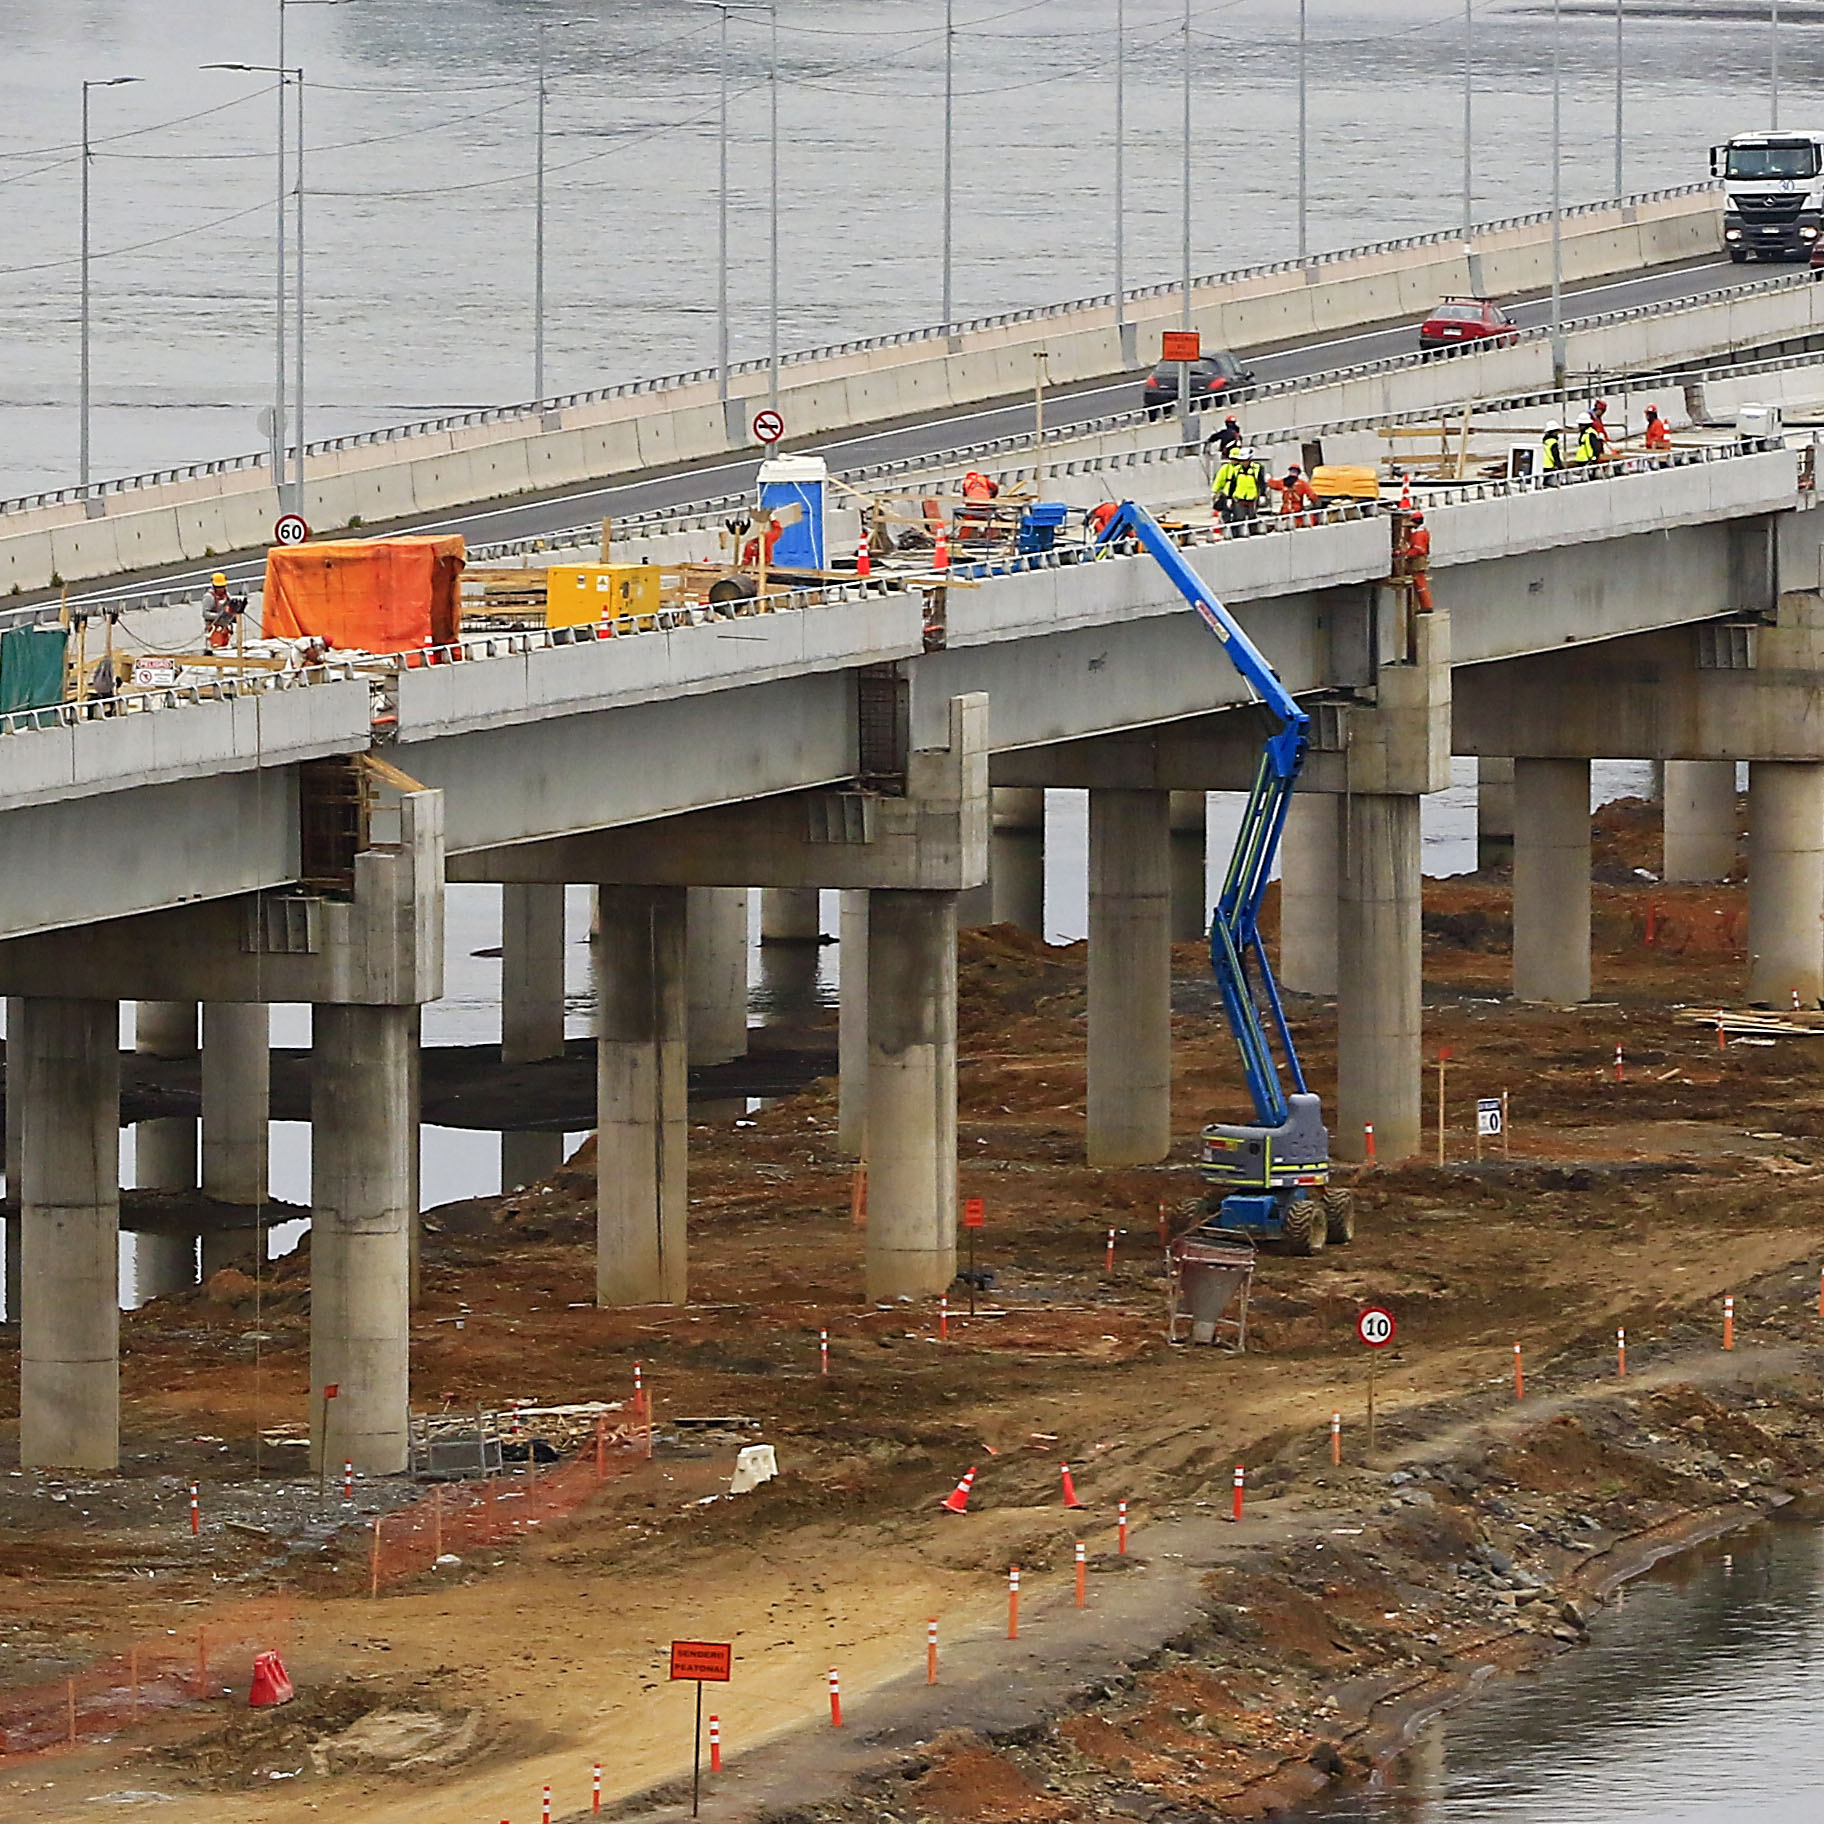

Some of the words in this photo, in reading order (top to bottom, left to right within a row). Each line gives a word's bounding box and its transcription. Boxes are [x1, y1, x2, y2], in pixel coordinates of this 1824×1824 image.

[280, 523, 302, 540] 60
[1366, 1317, 1389, 1337] 10
[677, 1649, 725, 1659] SENDERO
[674, 1662, 726, 1673] PEATONAL
